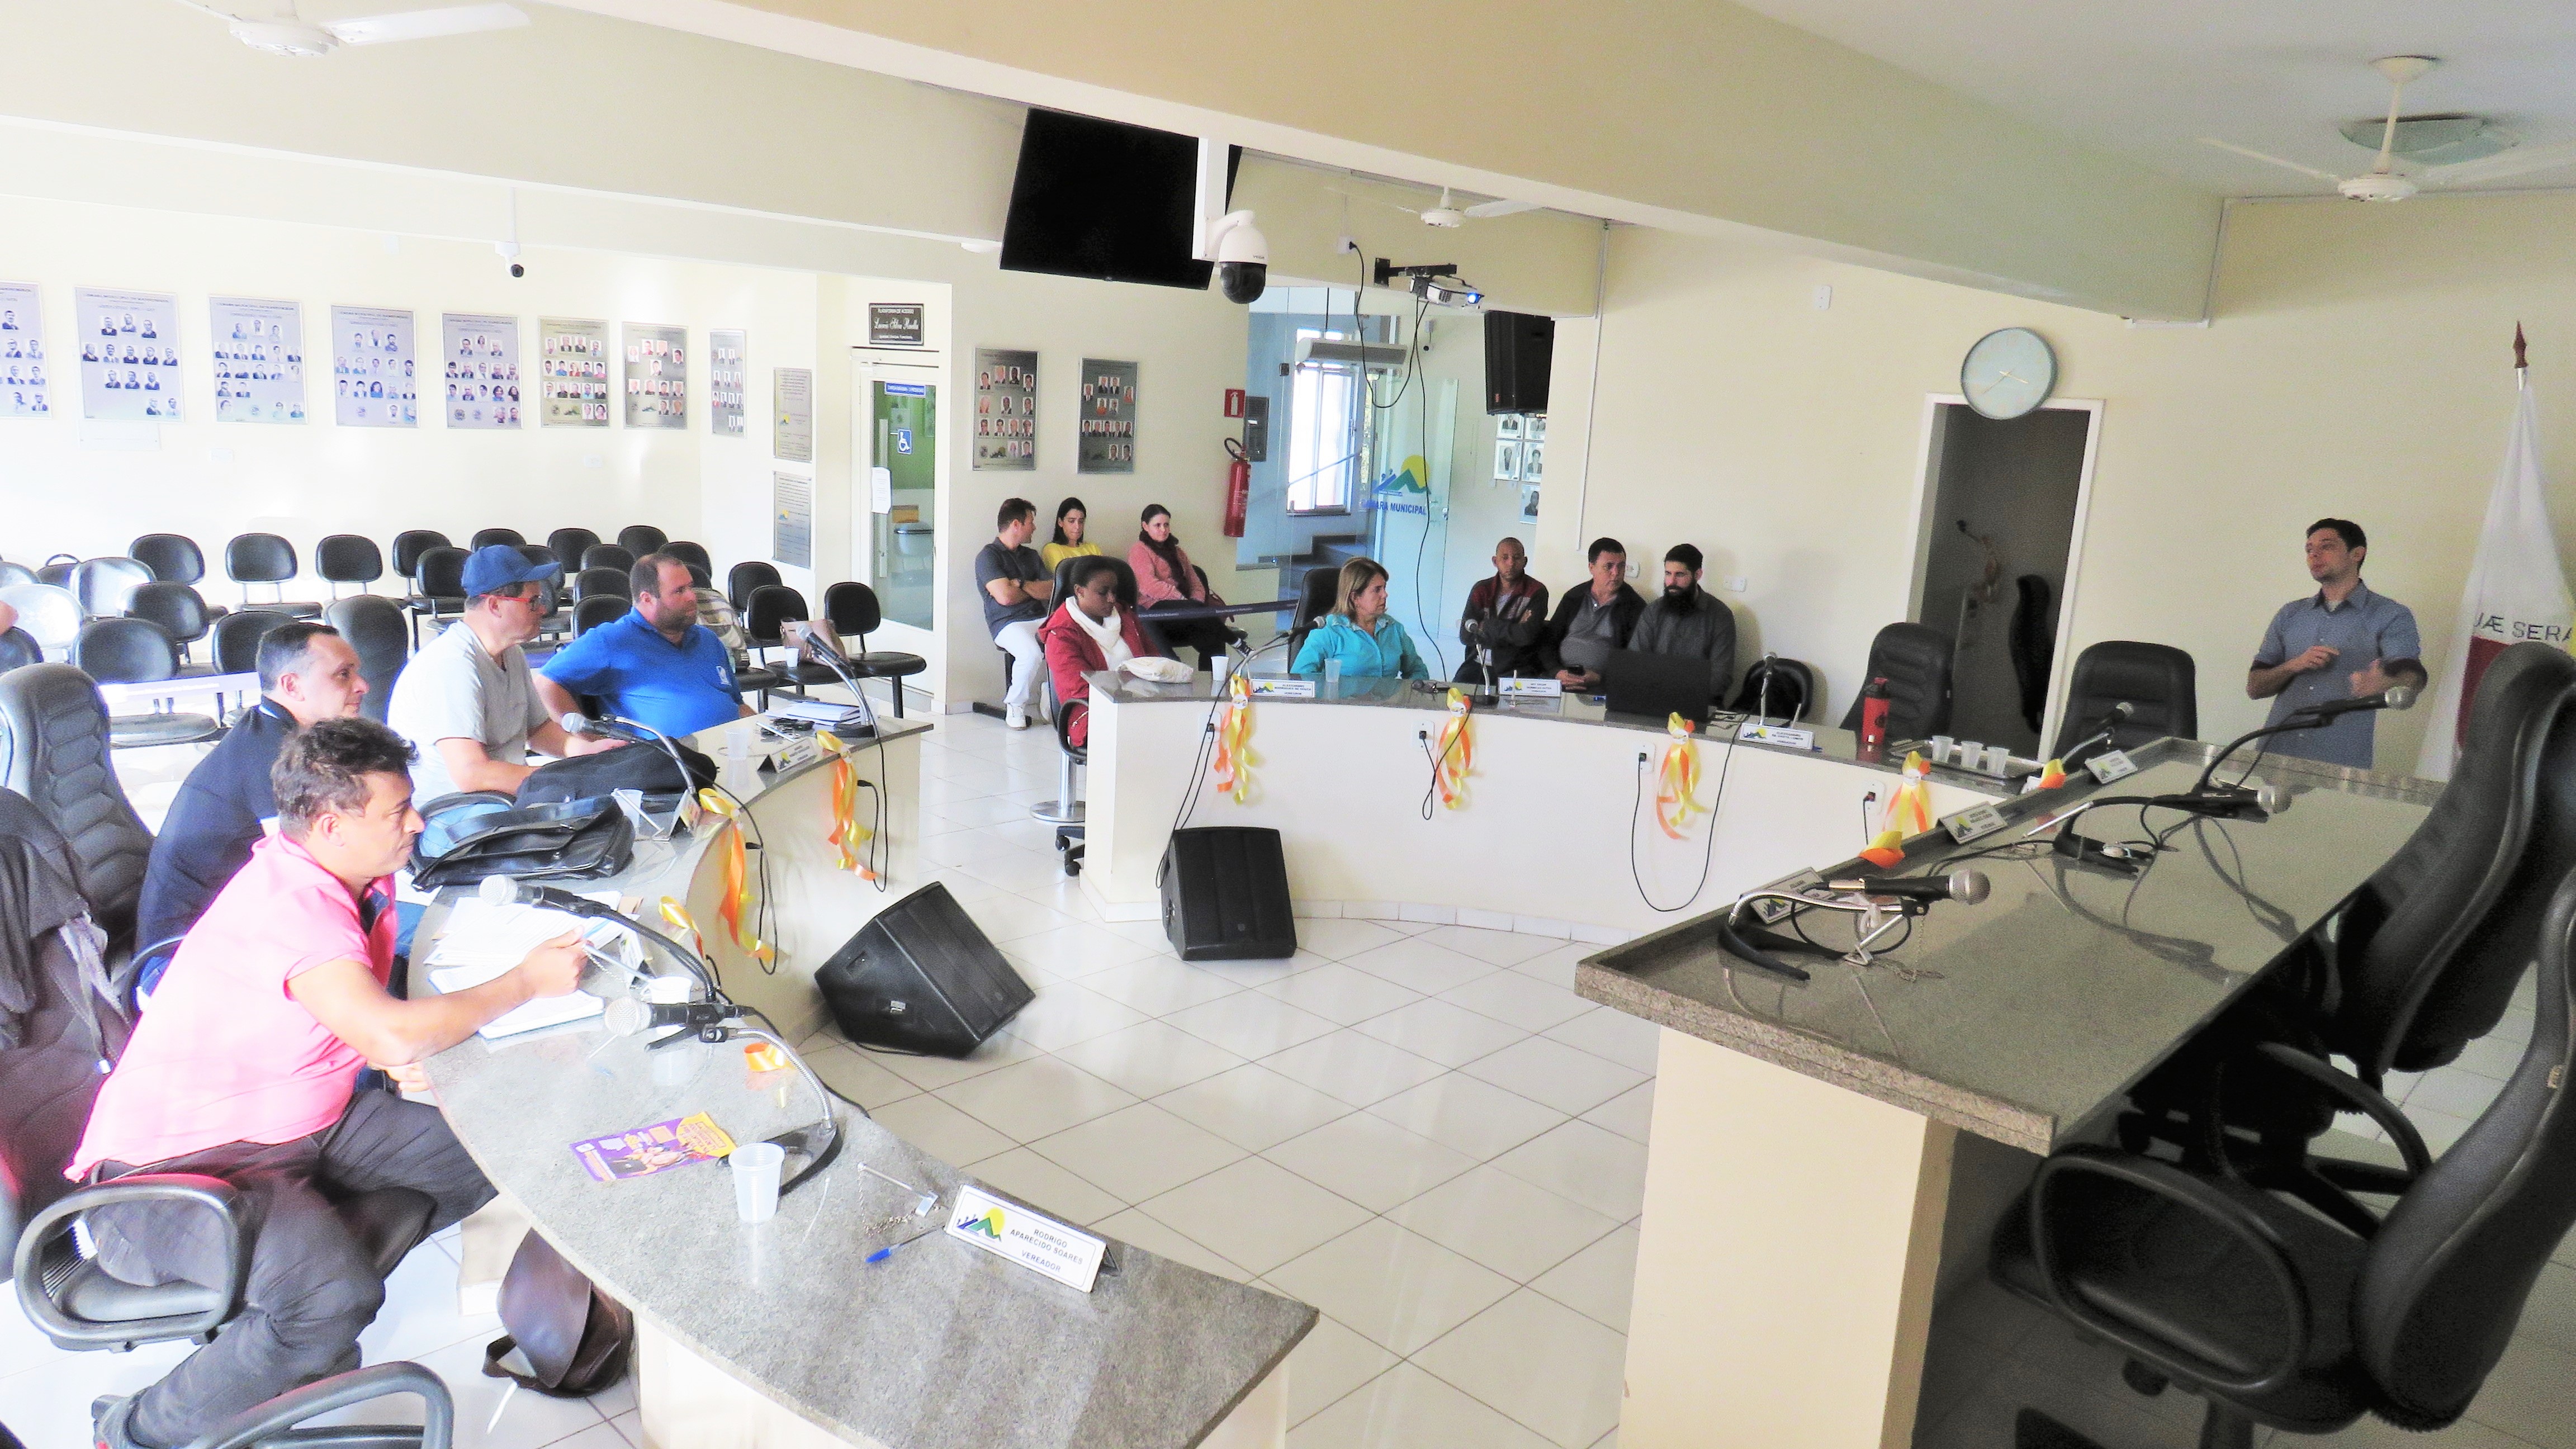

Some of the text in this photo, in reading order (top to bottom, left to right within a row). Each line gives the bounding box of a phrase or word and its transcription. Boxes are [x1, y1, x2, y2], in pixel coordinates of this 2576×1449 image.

[1390, 503, 1427, 515] MUNICIPAL
[1010, 1229, 1083, 1265] APARECIDO SOARES
[1034, 1229, 1067, 1248] RODRIGO
[1021, 1249, 1061, 1273] VEREADOR
